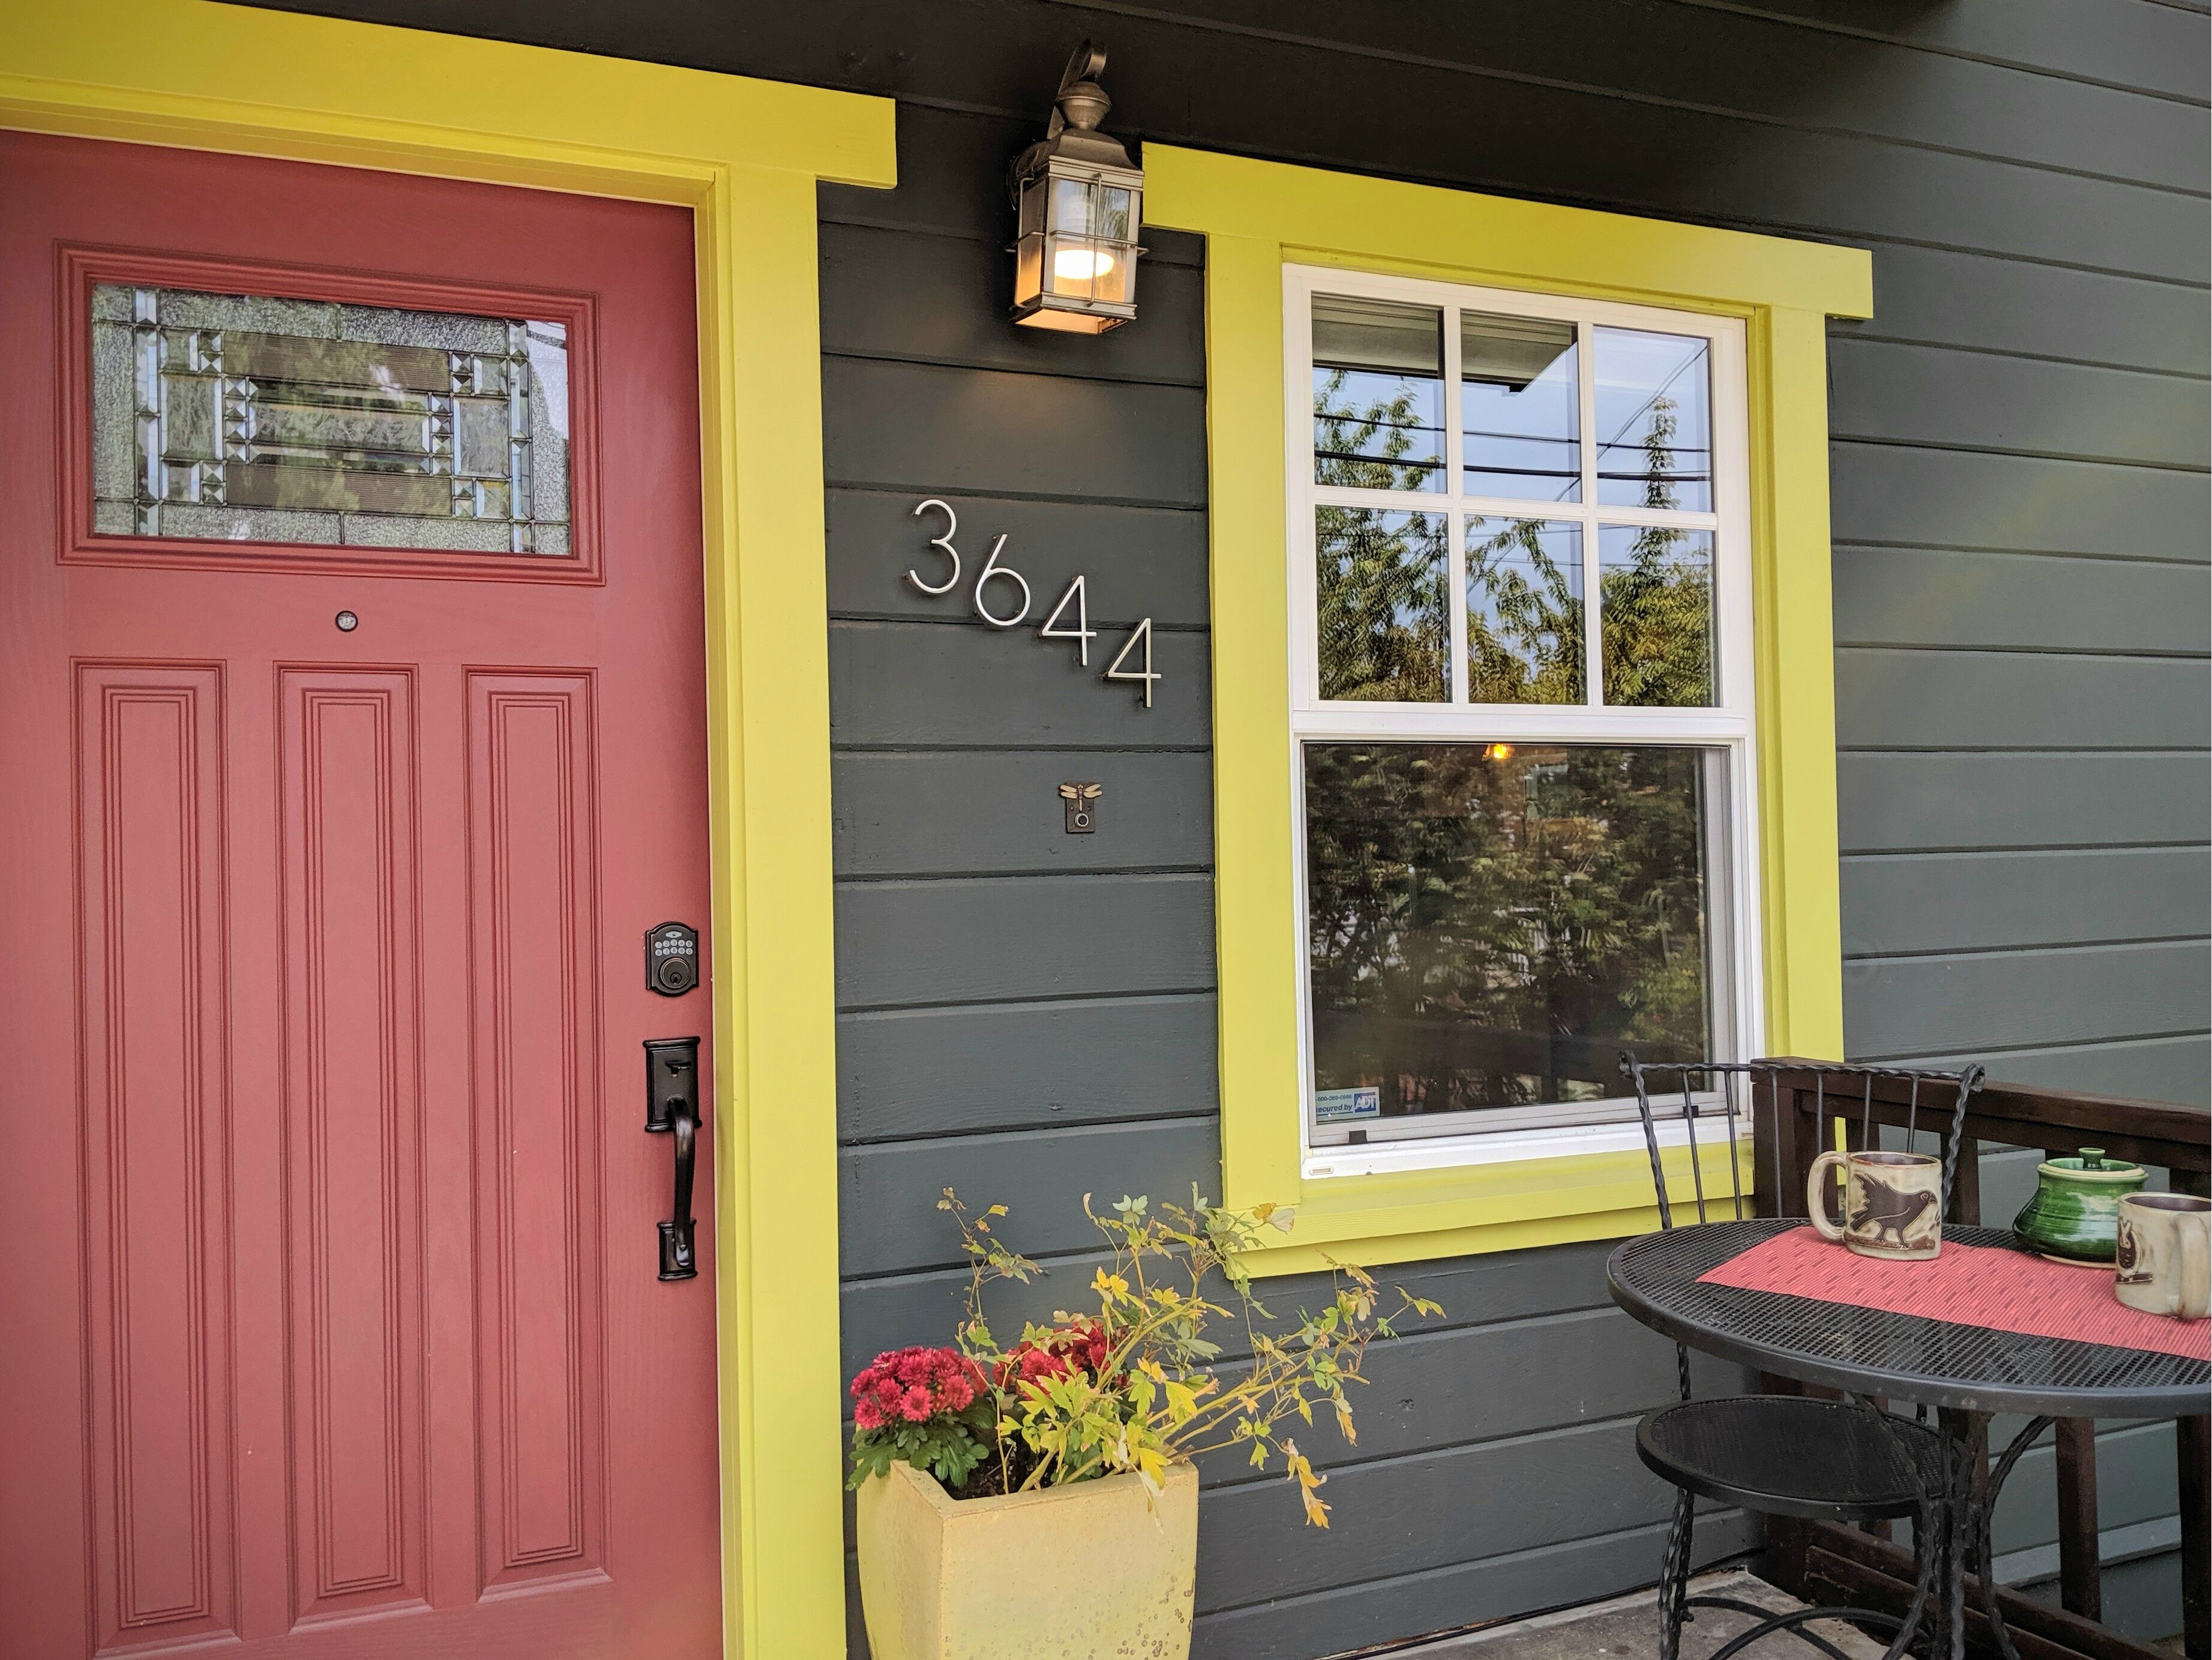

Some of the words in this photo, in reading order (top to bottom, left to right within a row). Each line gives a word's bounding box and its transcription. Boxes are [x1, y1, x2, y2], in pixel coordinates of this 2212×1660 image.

[909, 499, 1161, 708] 3644
[1344, 1103, 1353, 1111] by
[1354, 1095, 1375, 1110] ADT
